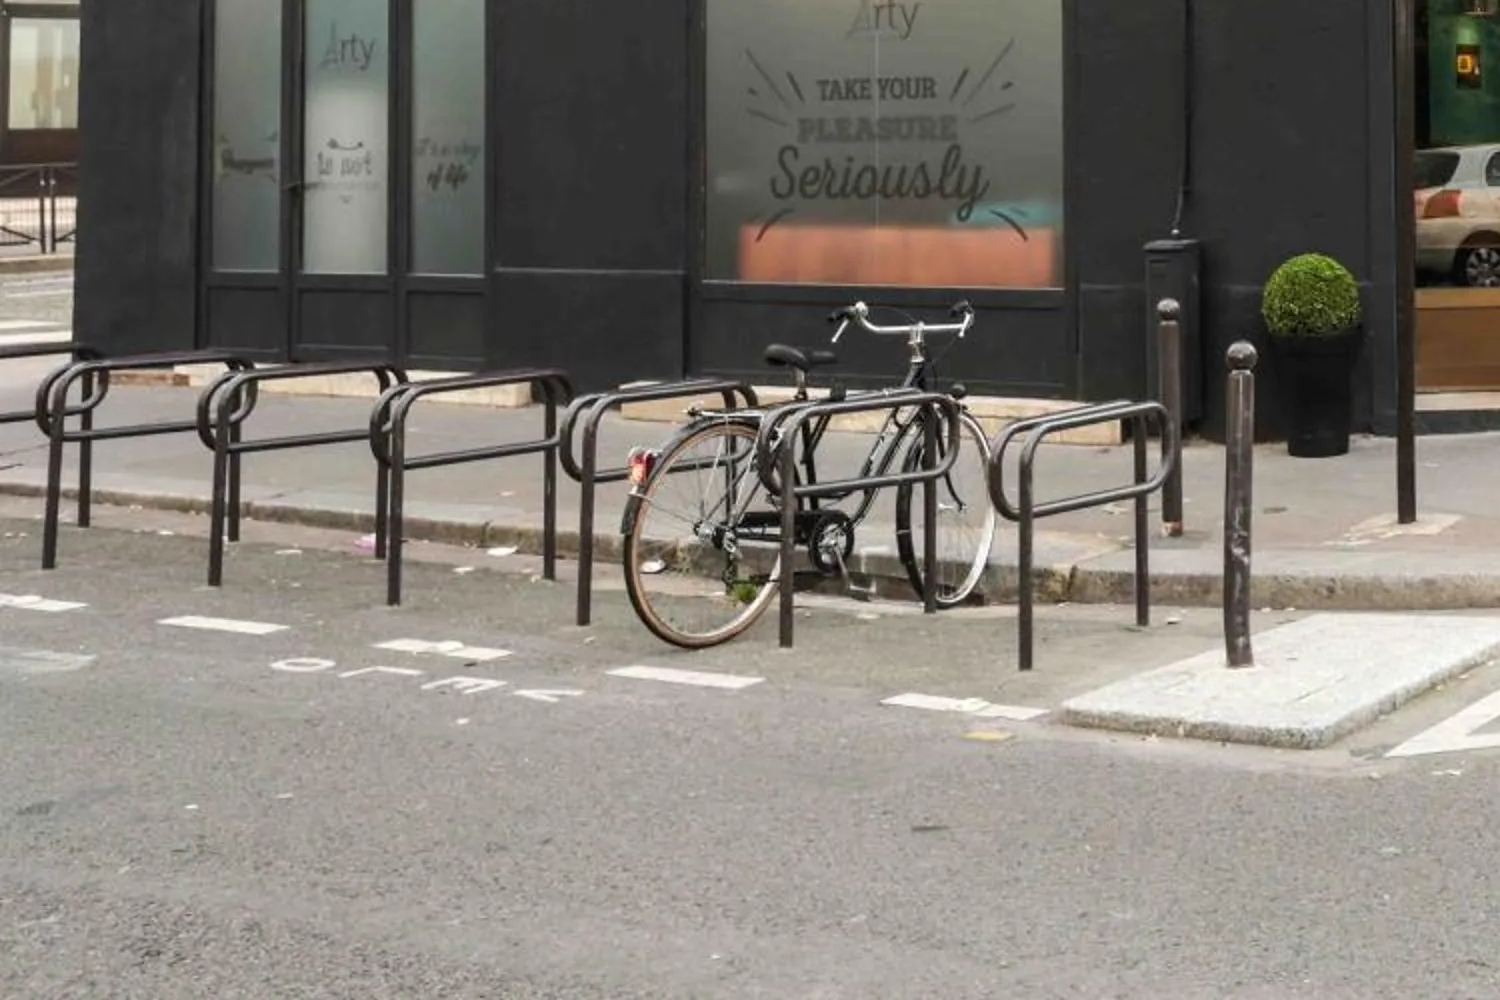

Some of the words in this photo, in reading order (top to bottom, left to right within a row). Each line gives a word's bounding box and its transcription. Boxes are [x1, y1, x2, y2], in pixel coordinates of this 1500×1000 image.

[317, 19, 377, 70] Arty
[816, 79, 872, 101] TAKE
[877, 77, 937, 100] YOUR
[796, 115, 958, 144] PLEASURE
[770, 144, 990, 222] Seriously
